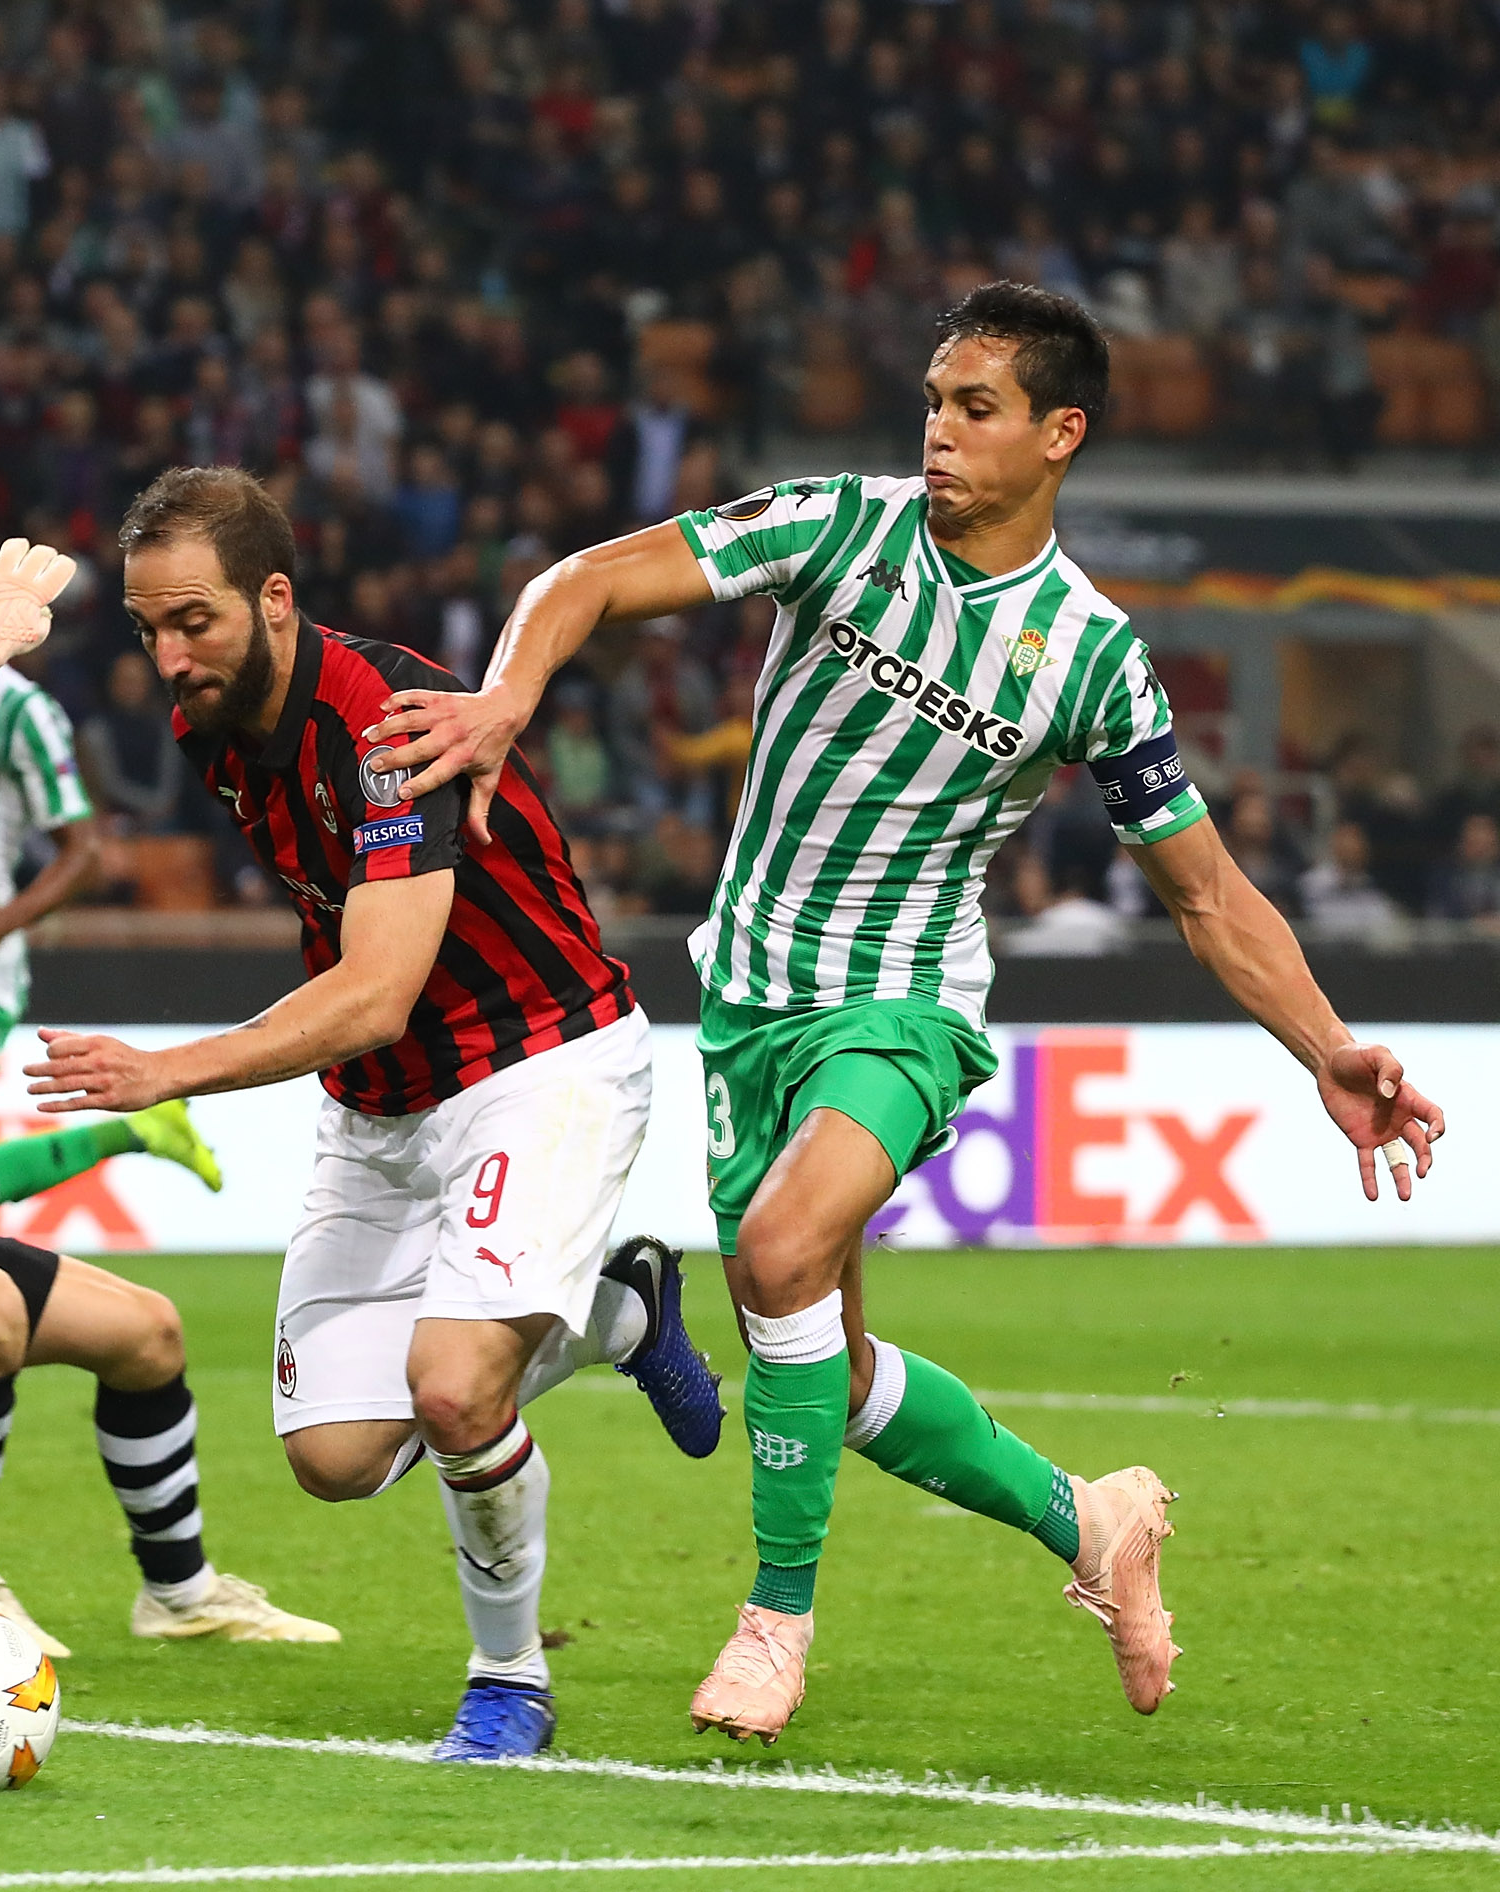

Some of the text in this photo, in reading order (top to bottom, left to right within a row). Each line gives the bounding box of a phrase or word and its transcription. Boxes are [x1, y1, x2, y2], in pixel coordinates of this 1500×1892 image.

[829, 622, 1024, 757] OTCDESKS
[380, 773, 391, 790] 7
[364, 822, 424, 844] RESPECT
[707, 1072, 736, 1159] 3
[465, 1151, 510, 1229] 9
